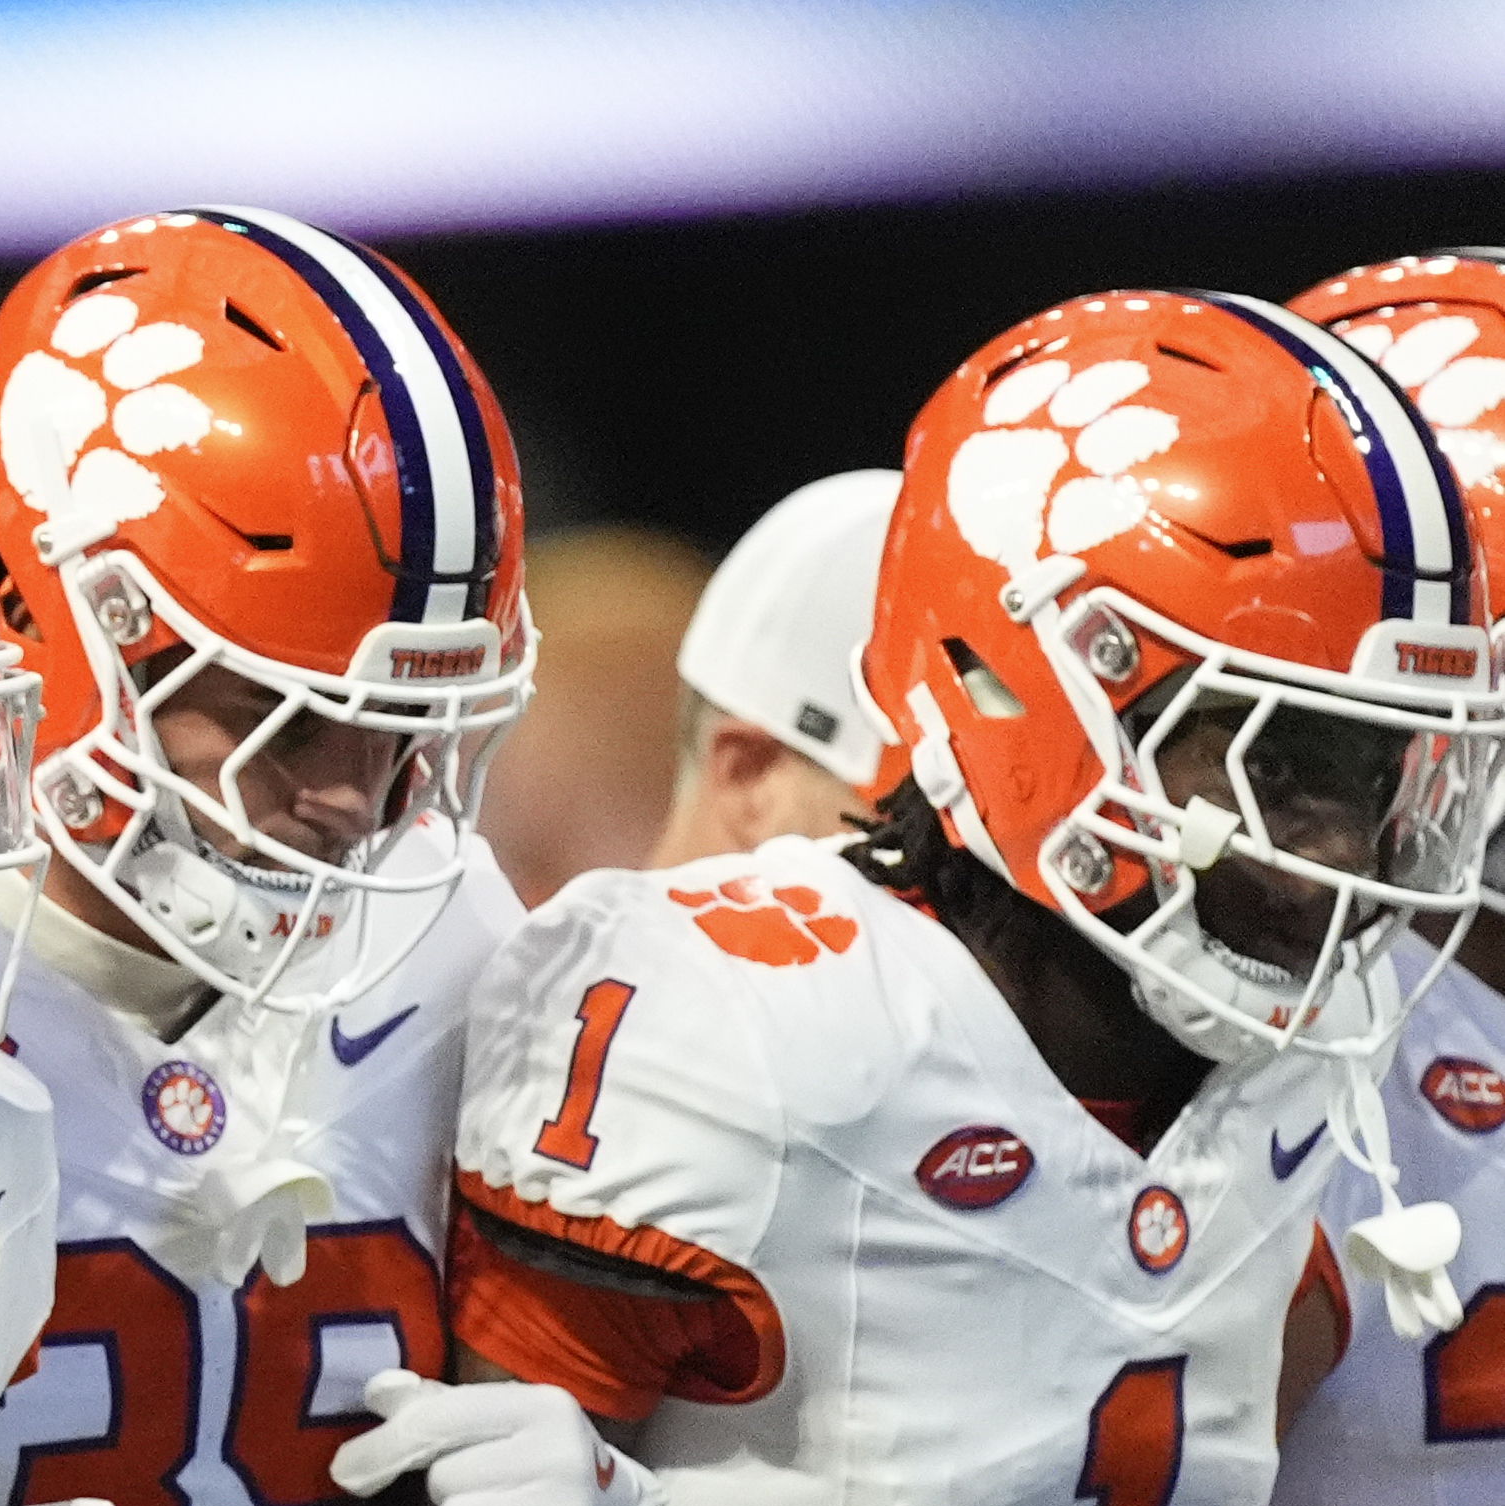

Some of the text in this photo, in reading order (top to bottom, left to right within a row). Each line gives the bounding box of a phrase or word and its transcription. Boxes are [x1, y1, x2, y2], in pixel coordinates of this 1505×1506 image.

[390, 644, 486, 678] TIGERS
[533, 977, 637, 1170] 1
[1435, 1070, 1504, 1105] ACC
[931, 1140, 1020, 1179] ACC
